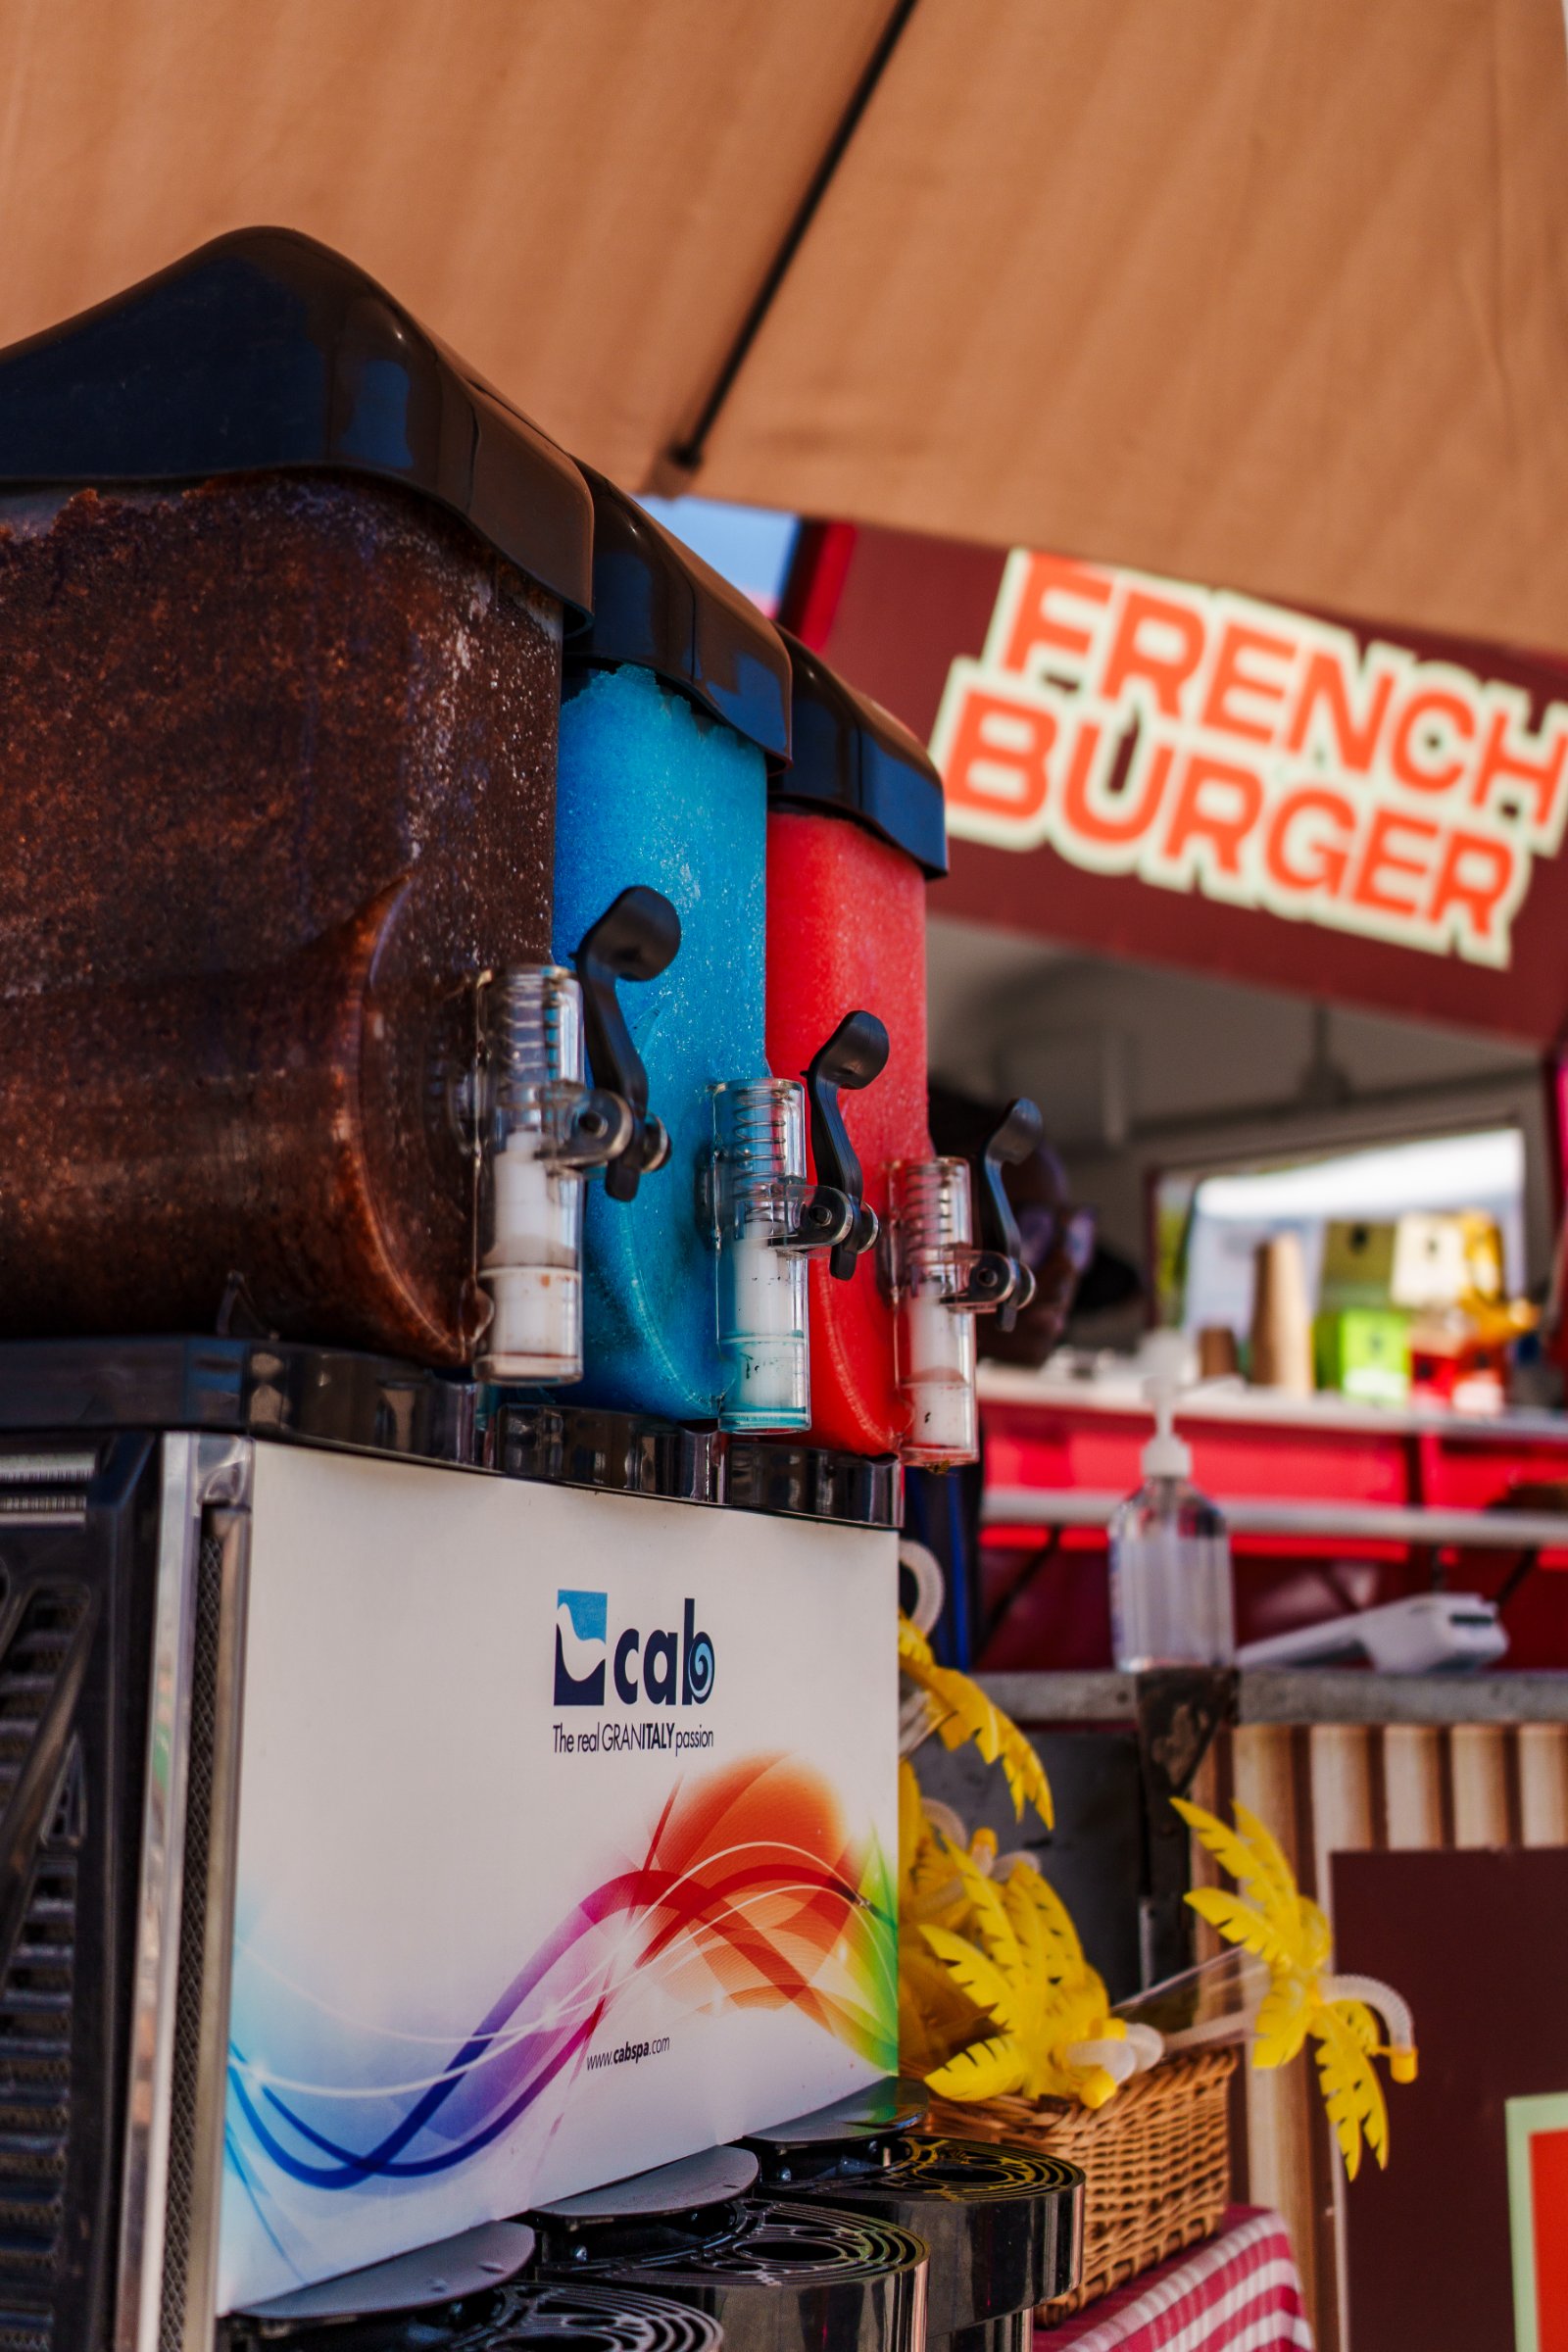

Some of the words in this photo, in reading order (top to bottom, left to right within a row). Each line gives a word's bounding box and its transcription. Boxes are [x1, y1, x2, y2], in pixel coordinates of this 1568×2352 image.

[998, 551, 1568, 828] FRENCH
[943, 687, 1517, 939] BURGER
[613, 1597, 715, 1705] cab
[553, 1722, 574, 1753] The
[577, 1722, 600, 1752] real
[602, 1723, 675, 1751] GRANITALY
[675, 1725, 714, 1756] passion
[586, 2036, 670, 2071] www.cabspa.com
